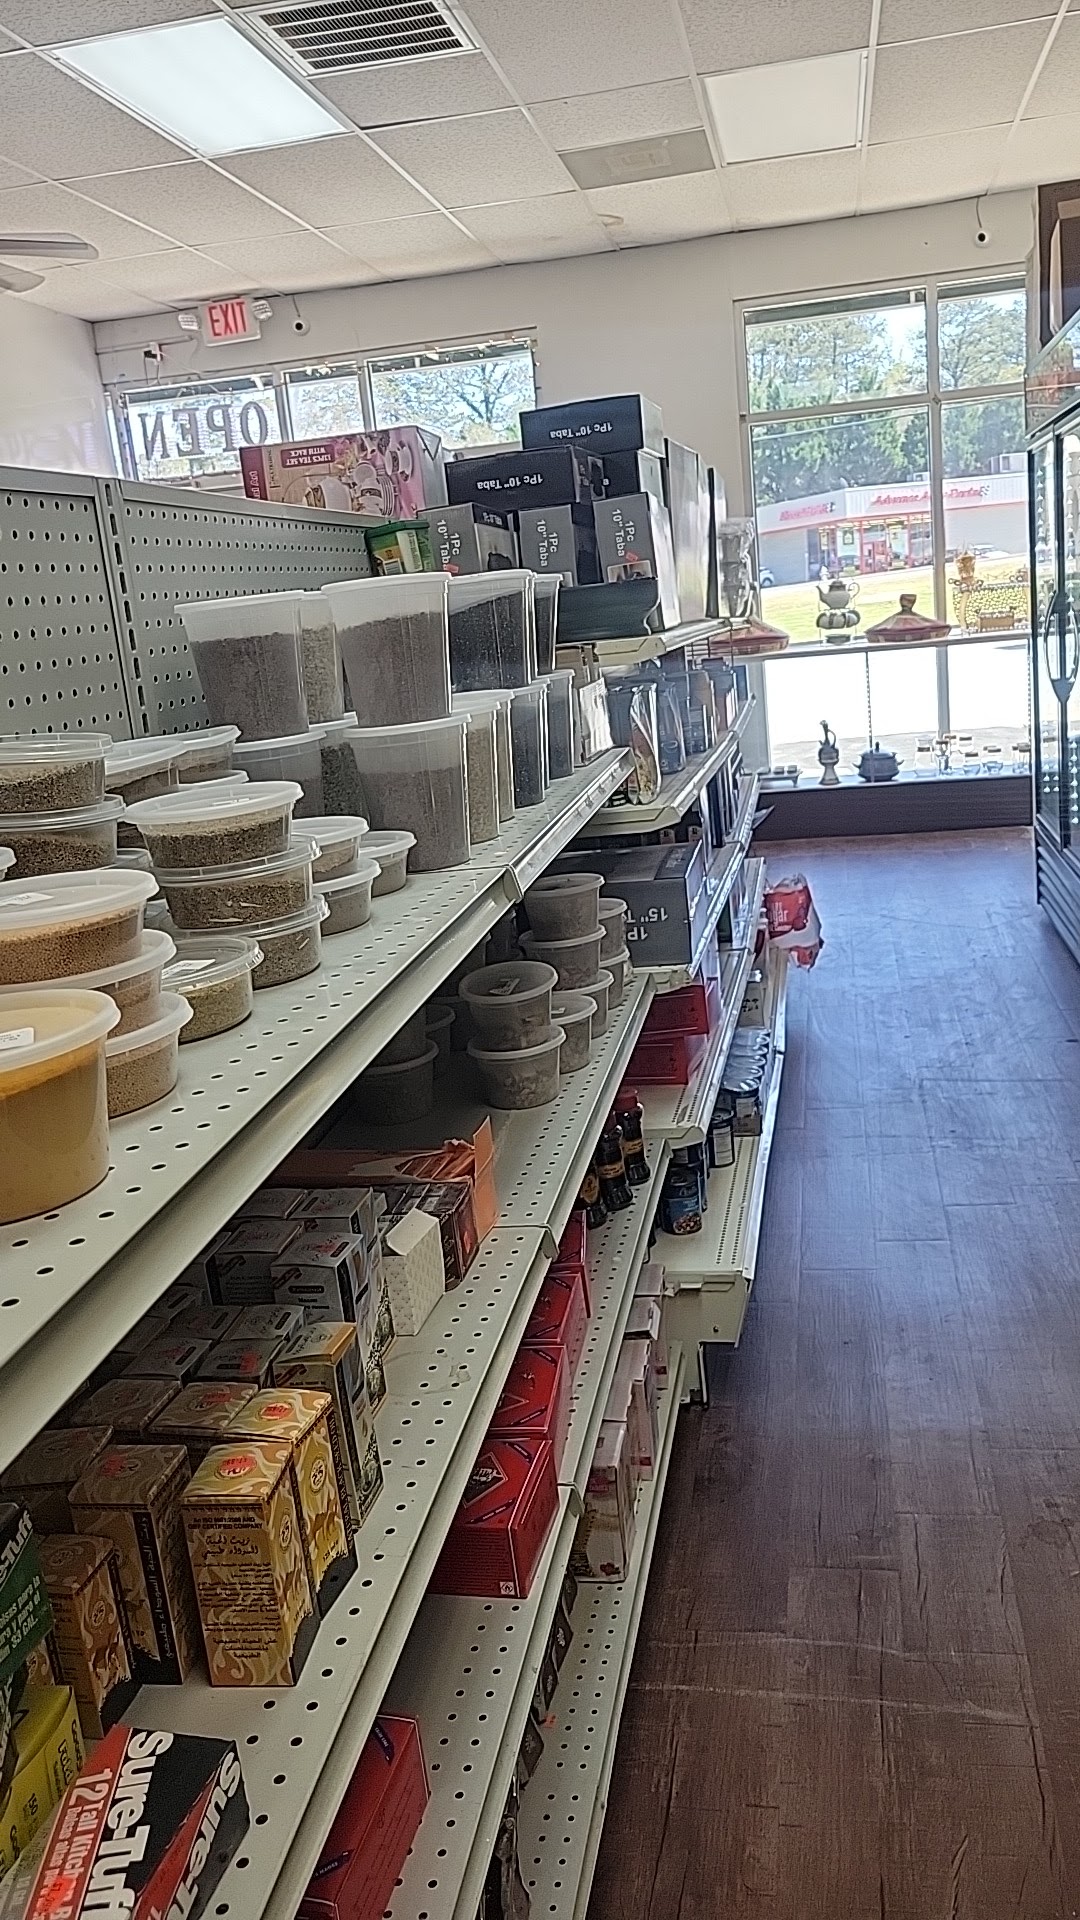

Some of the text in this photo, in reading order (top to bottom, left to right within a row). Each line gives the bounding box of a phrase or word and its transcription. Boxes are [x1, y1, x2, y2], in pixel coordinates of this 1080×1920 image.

[209, 300, 249, 337] EXIT
[549, 428, 574, 439] Taba
[593, 421, 613, 433] 1Pc
[290, 447, 326, 457] WITH RACK
[299, 456, 312, 464] TEA
[476, 479, 502, 490] Taba
[523, 473, 544, 485] 1Pc
[549, 532, 559, 553] 1Pc
[625, 520, 635, 543] 1Pc
[450, 533, 460, 555] 1Pc
[538, 542, 548, 567] Taba
[614, 530, 625, 557] Taba
[627, 926, 648, 941] 1P
[57, 1738, 75, 1786] Fold
[71, 1768, 113, 1806] 12
[28, 1792, 38, 1816] 150
[59, 1804, 83, 1843] Bolsas
[77, 1799, 105, 1834] Tall
[50, 1840, 71, 1867] altas
